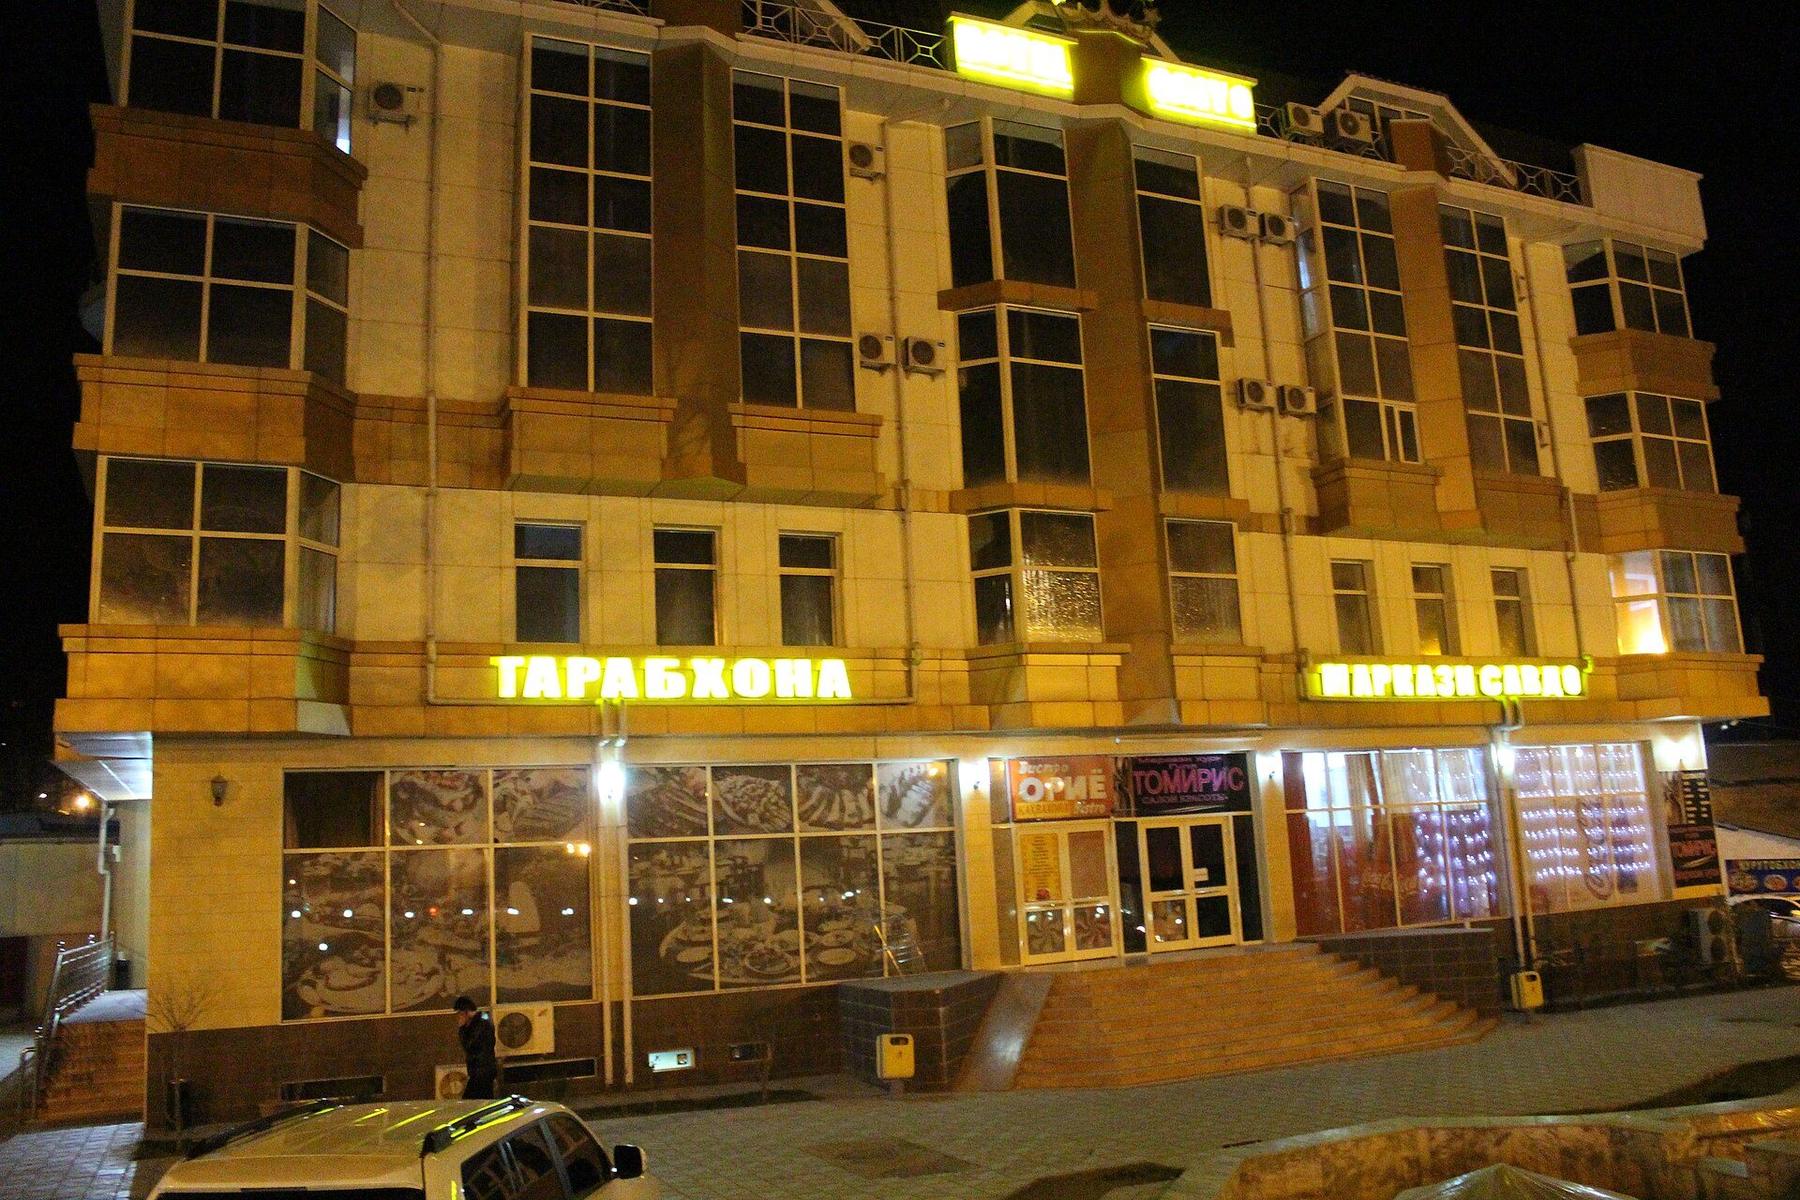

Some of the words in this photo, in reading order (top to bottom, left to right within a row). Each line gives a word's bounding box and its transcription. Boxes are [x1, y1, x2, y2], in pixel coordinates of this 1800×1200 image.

[493, 655, 852, 699] ТАРАБХОНА
[1321, 663, 1476, 697] МАРКАЗИ
[1479, 664, 1582, 697] САВДО
[1132, 766, 1244, 795] ТОМИРИС
